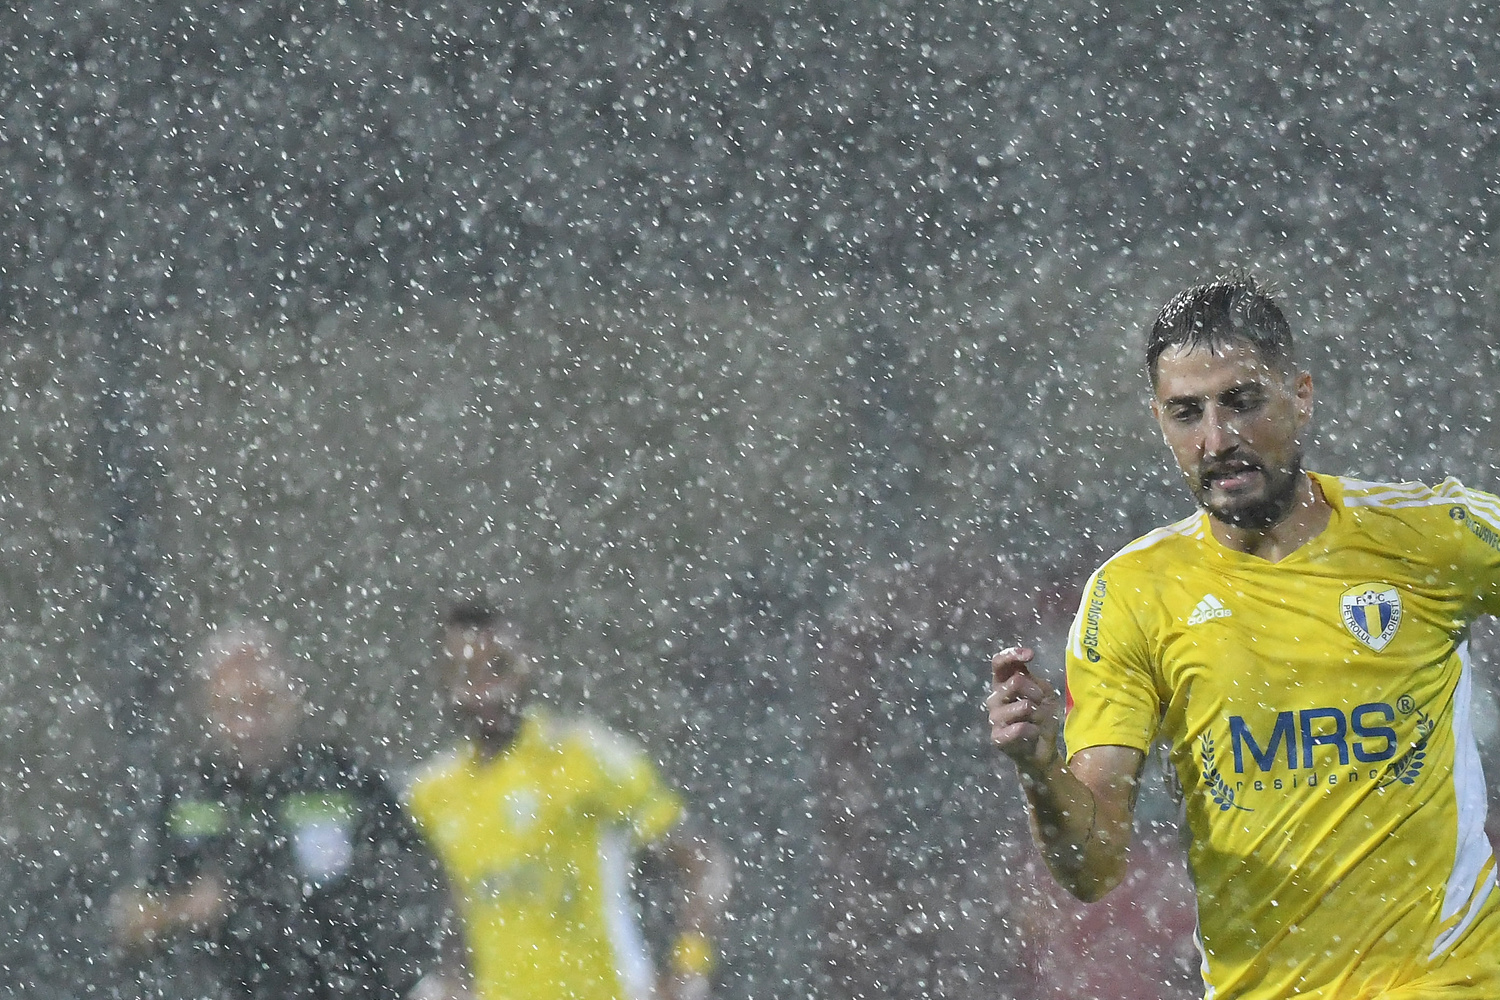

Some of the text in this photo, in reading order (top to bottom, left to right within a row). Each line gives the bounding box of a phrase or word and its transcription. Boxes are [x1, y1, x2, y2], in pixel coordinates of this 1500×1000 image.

[1465, 513, 1499, 549] XCLUSIVE
[1083, 599, 1104, 647] EXCLUSIVE
[1187, 608, 1232, 626] adidas
[1343, 604, 1371, 644] PETROLUL
[1236, 768, 1381, 792] residenc
